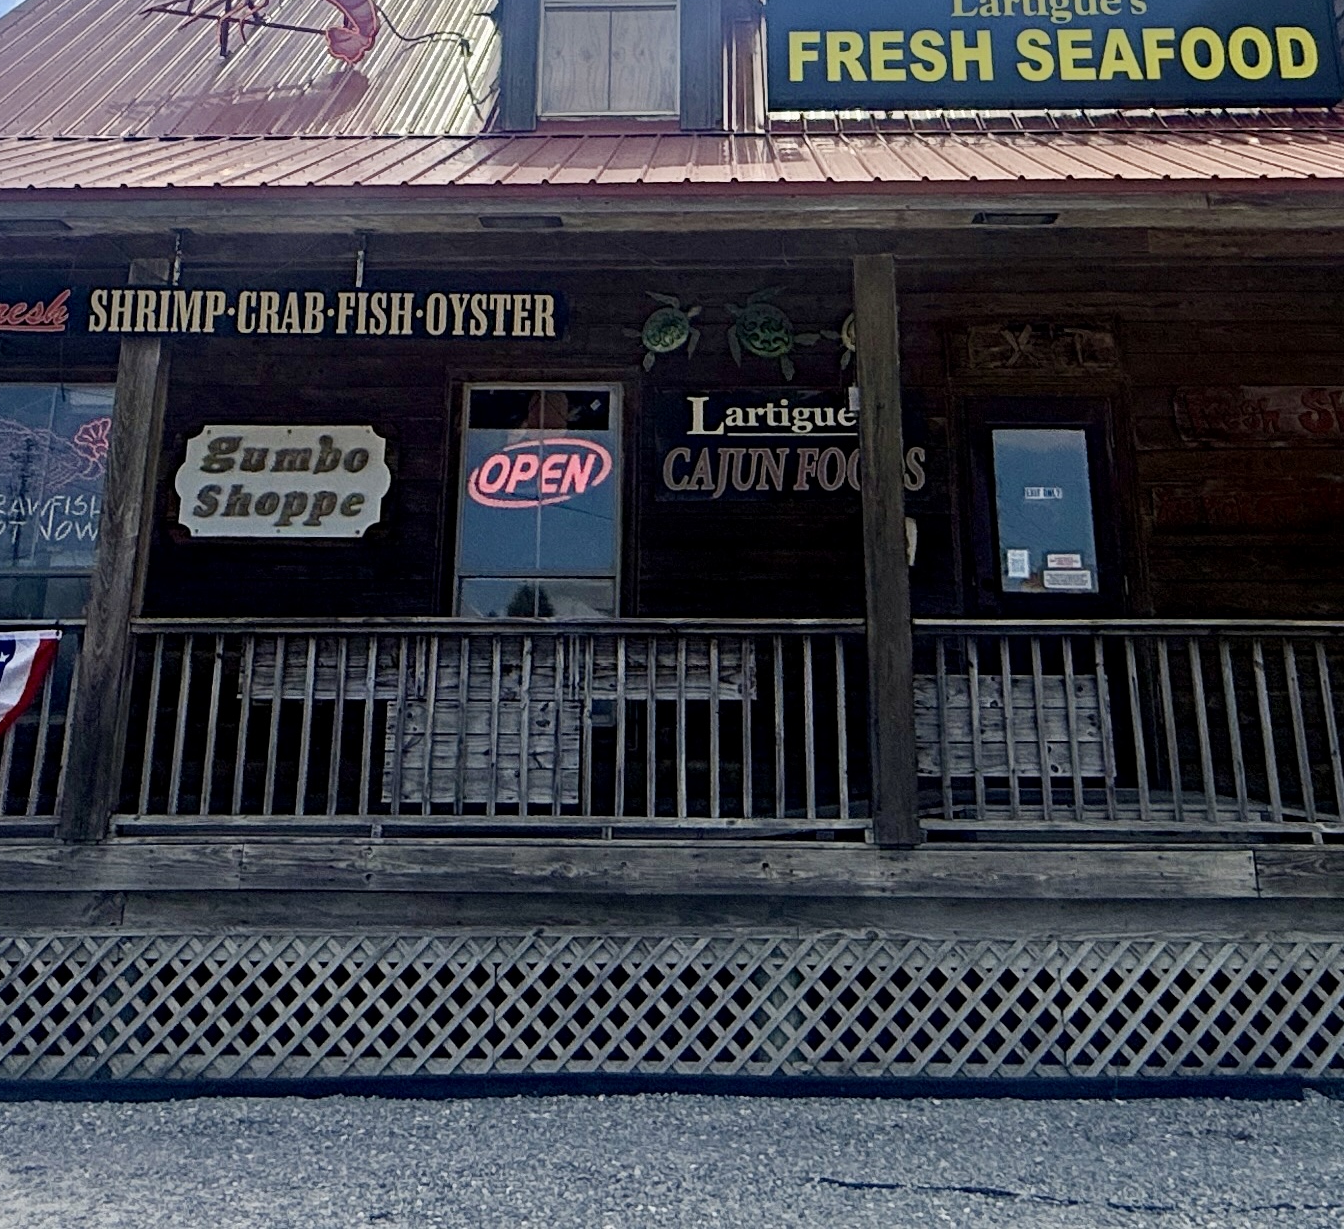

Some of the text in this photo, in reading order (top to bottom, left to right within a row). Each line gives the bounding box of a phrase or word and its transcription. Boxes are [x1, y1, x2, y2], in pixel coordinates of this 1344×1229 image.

[787, 26, 1320, 83] FRESH SEAFOOD
[478, 453, 598, 494] OPEN
[662, 446, 790, 499] CAJUN
[192, 483, 366, 527] Shoppe
